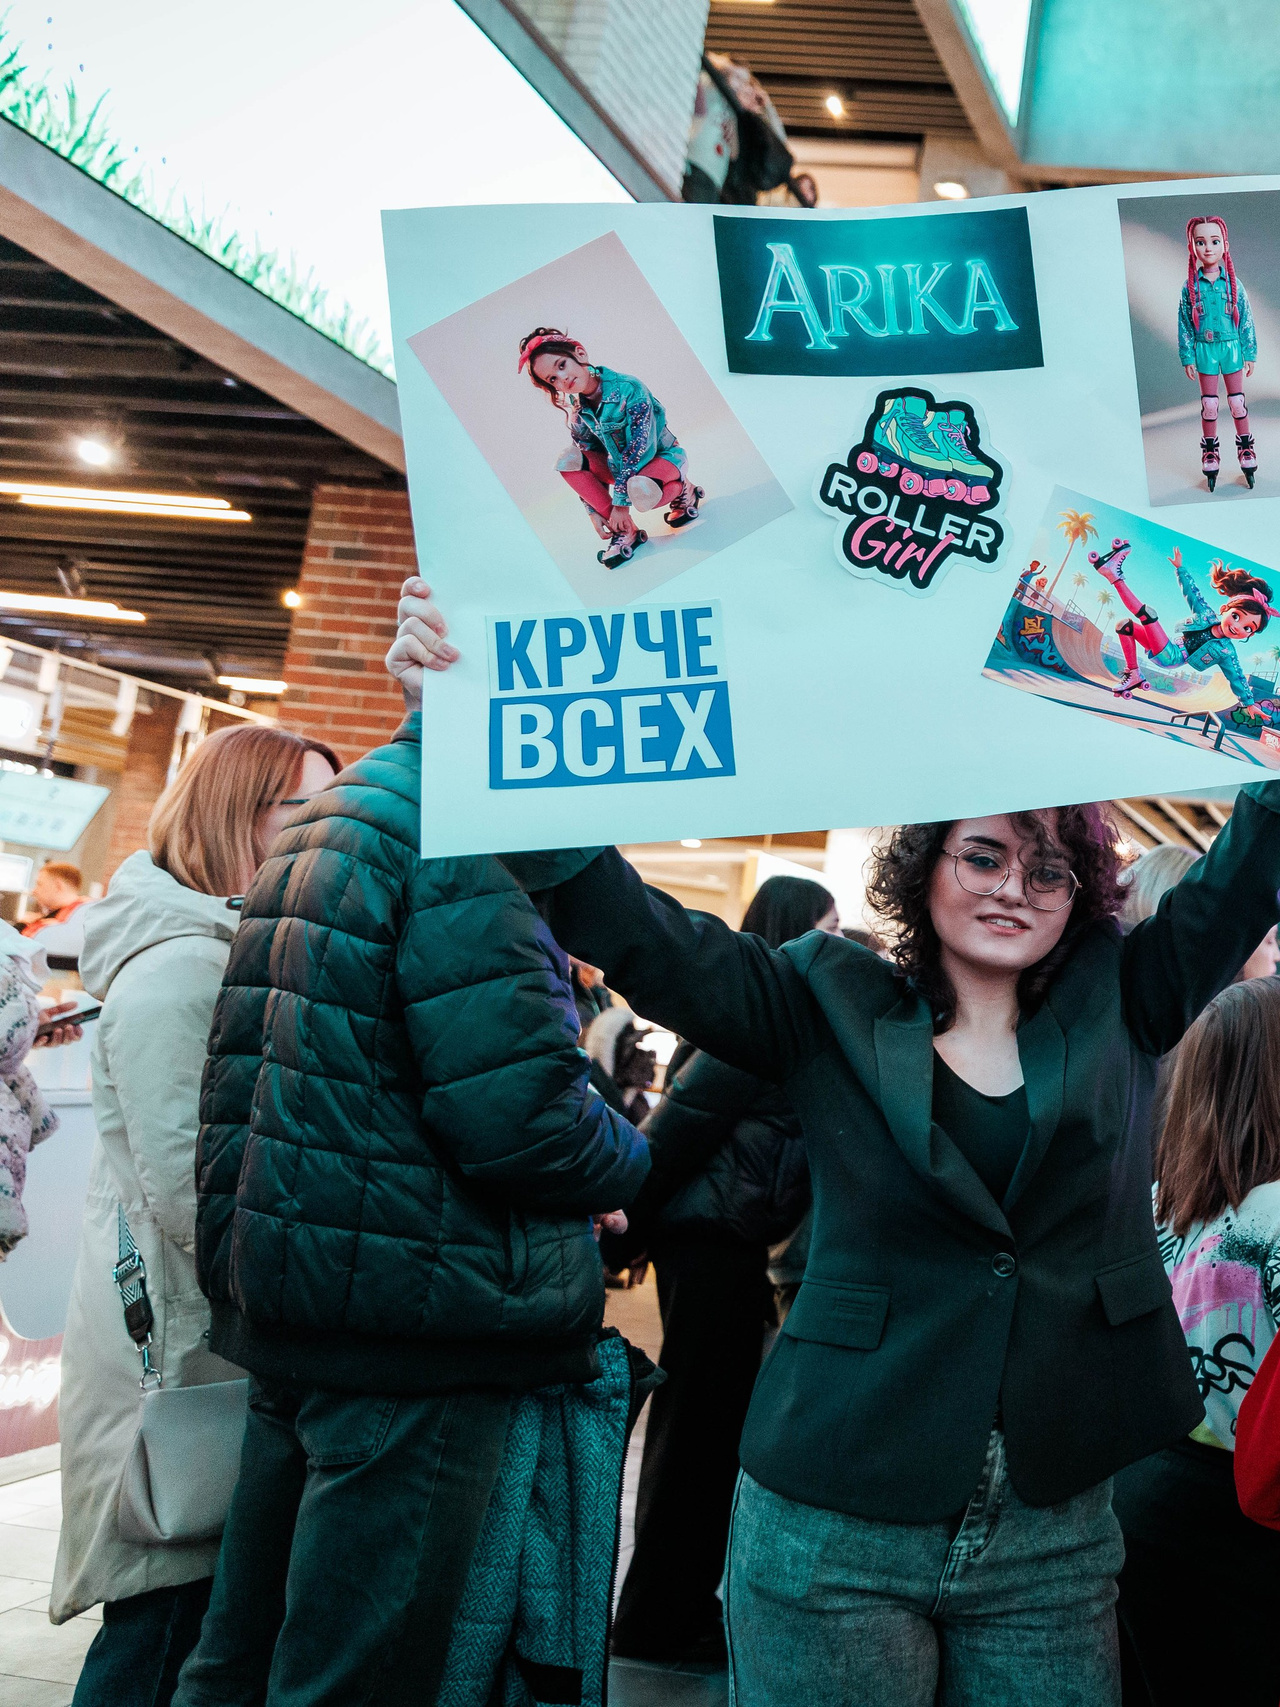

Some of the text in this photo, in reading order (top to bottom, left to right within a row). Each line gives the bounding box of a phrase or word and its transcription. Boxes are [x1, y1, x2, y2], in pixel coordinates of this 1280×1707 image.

[744, 242, 1020, 350] ARIKA
[827, 471, 996, 556] ROLLER
[850, 514, 957, 582] Girl
[494, 606, 719, 692] КРУЧЕ
[501, 689, 724, 781] ВСЕХ
